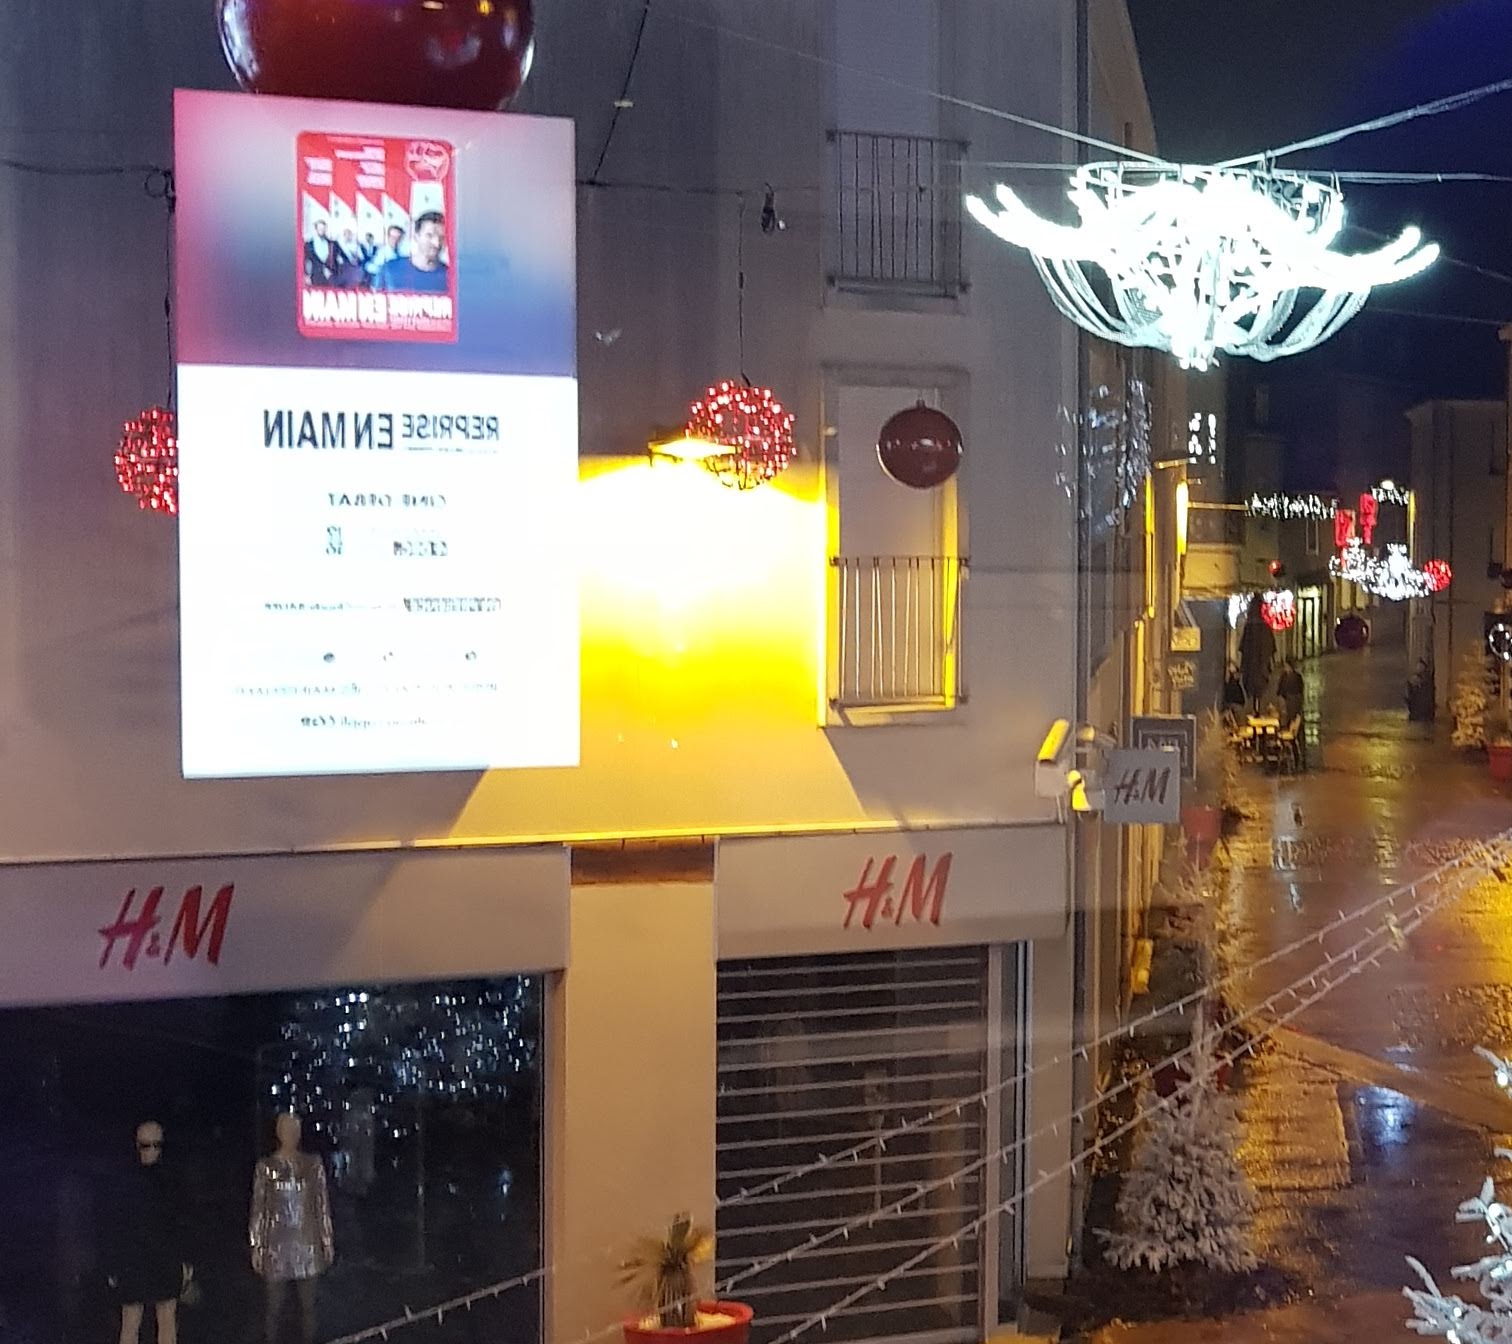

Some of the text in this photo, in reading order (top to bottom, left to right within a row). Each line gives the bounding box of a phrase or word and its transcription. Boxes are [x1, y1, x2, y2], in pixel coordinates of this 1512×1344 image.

[1112, 766, 1171, 806] H&M
[98, 881, 235, 971] H&M
[842, 851, 952, 929] H&M
